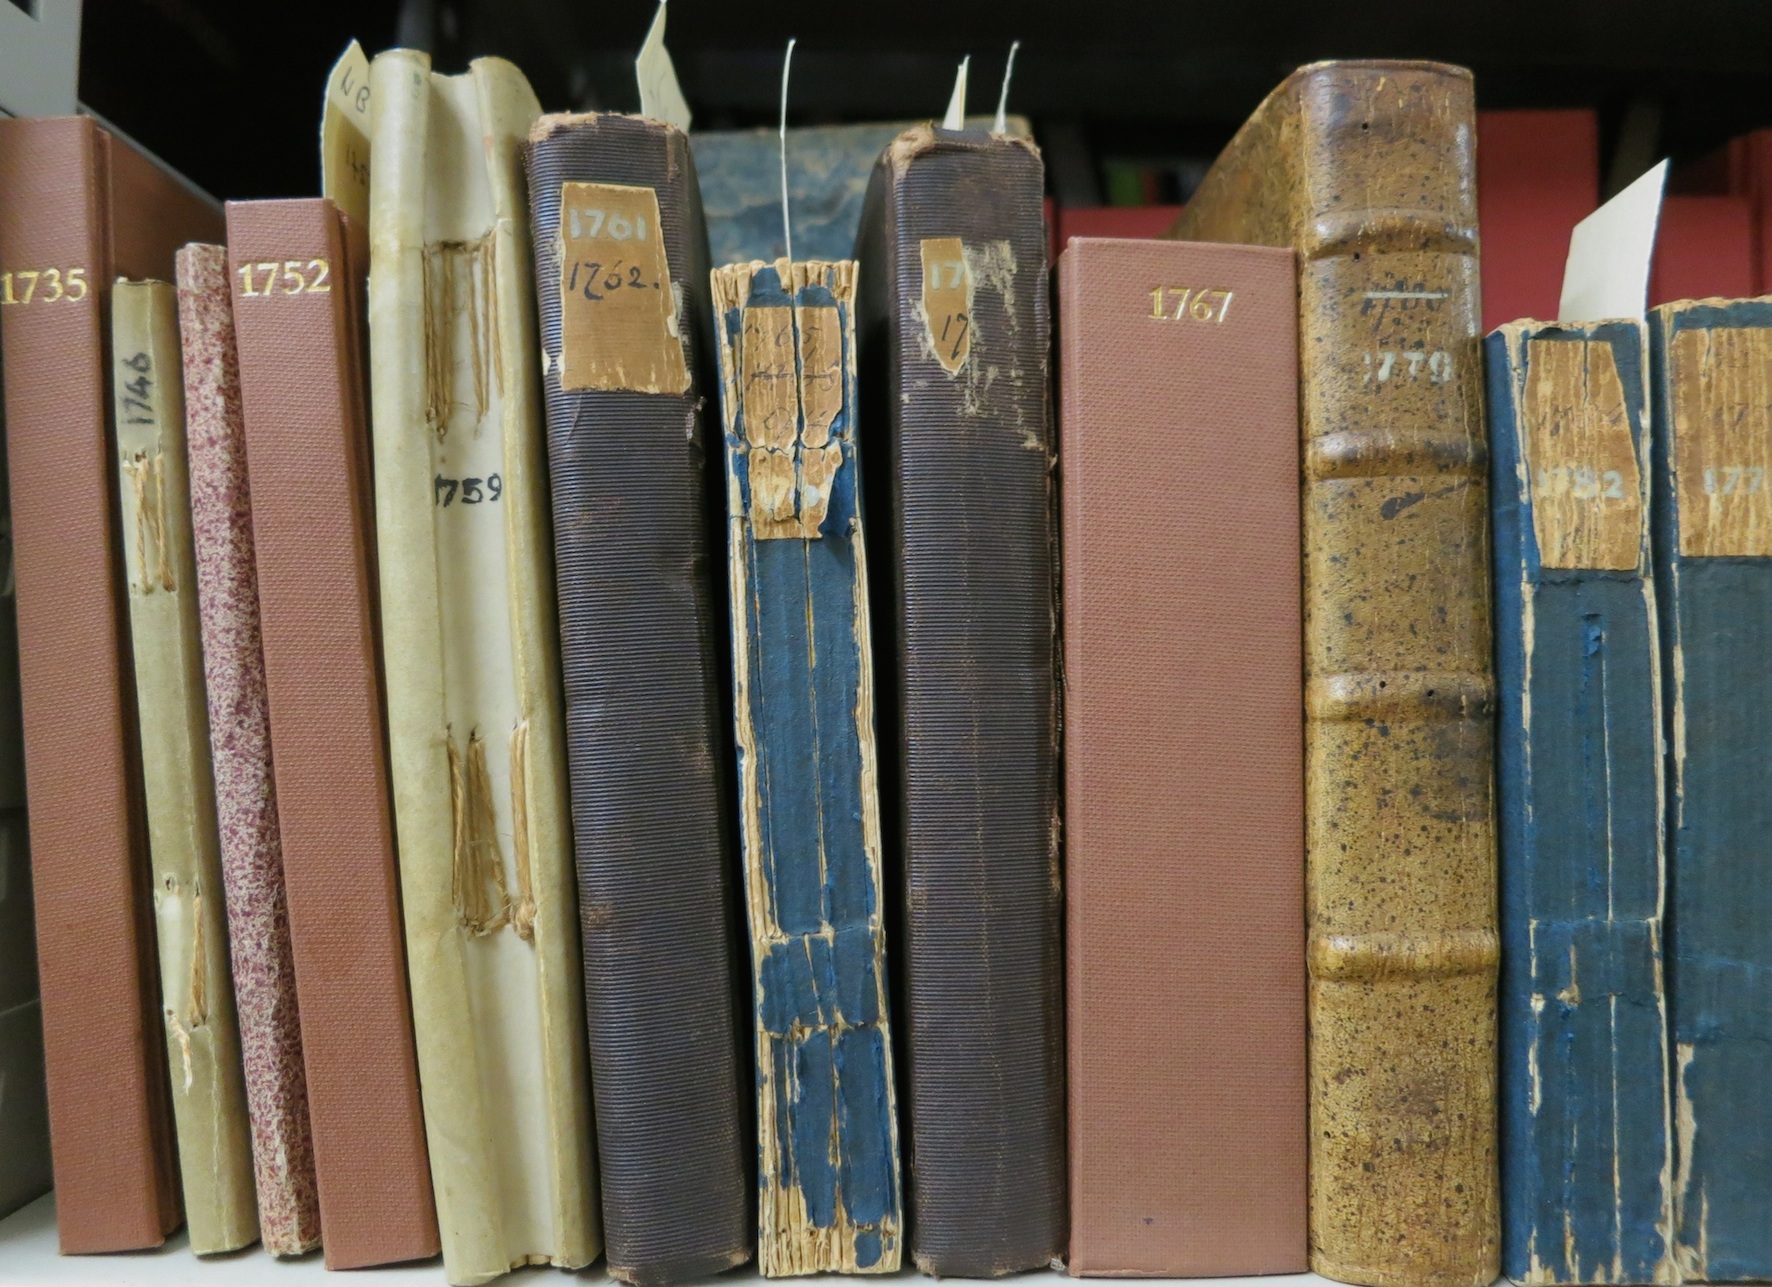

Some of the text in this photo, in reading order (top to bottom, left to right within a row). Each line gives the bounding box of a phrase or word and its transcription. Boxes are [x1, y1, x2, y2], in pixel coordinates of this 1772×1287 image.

[568, 207, 648, 242] 1761
[1, 267, 88, 305] 1735
[238, 258, 331, 298] 1752
[1147, 286, 1233, 323] 1767
[121, 351, 156, 426] 1746
[433, 472, 502, 508] 1759
